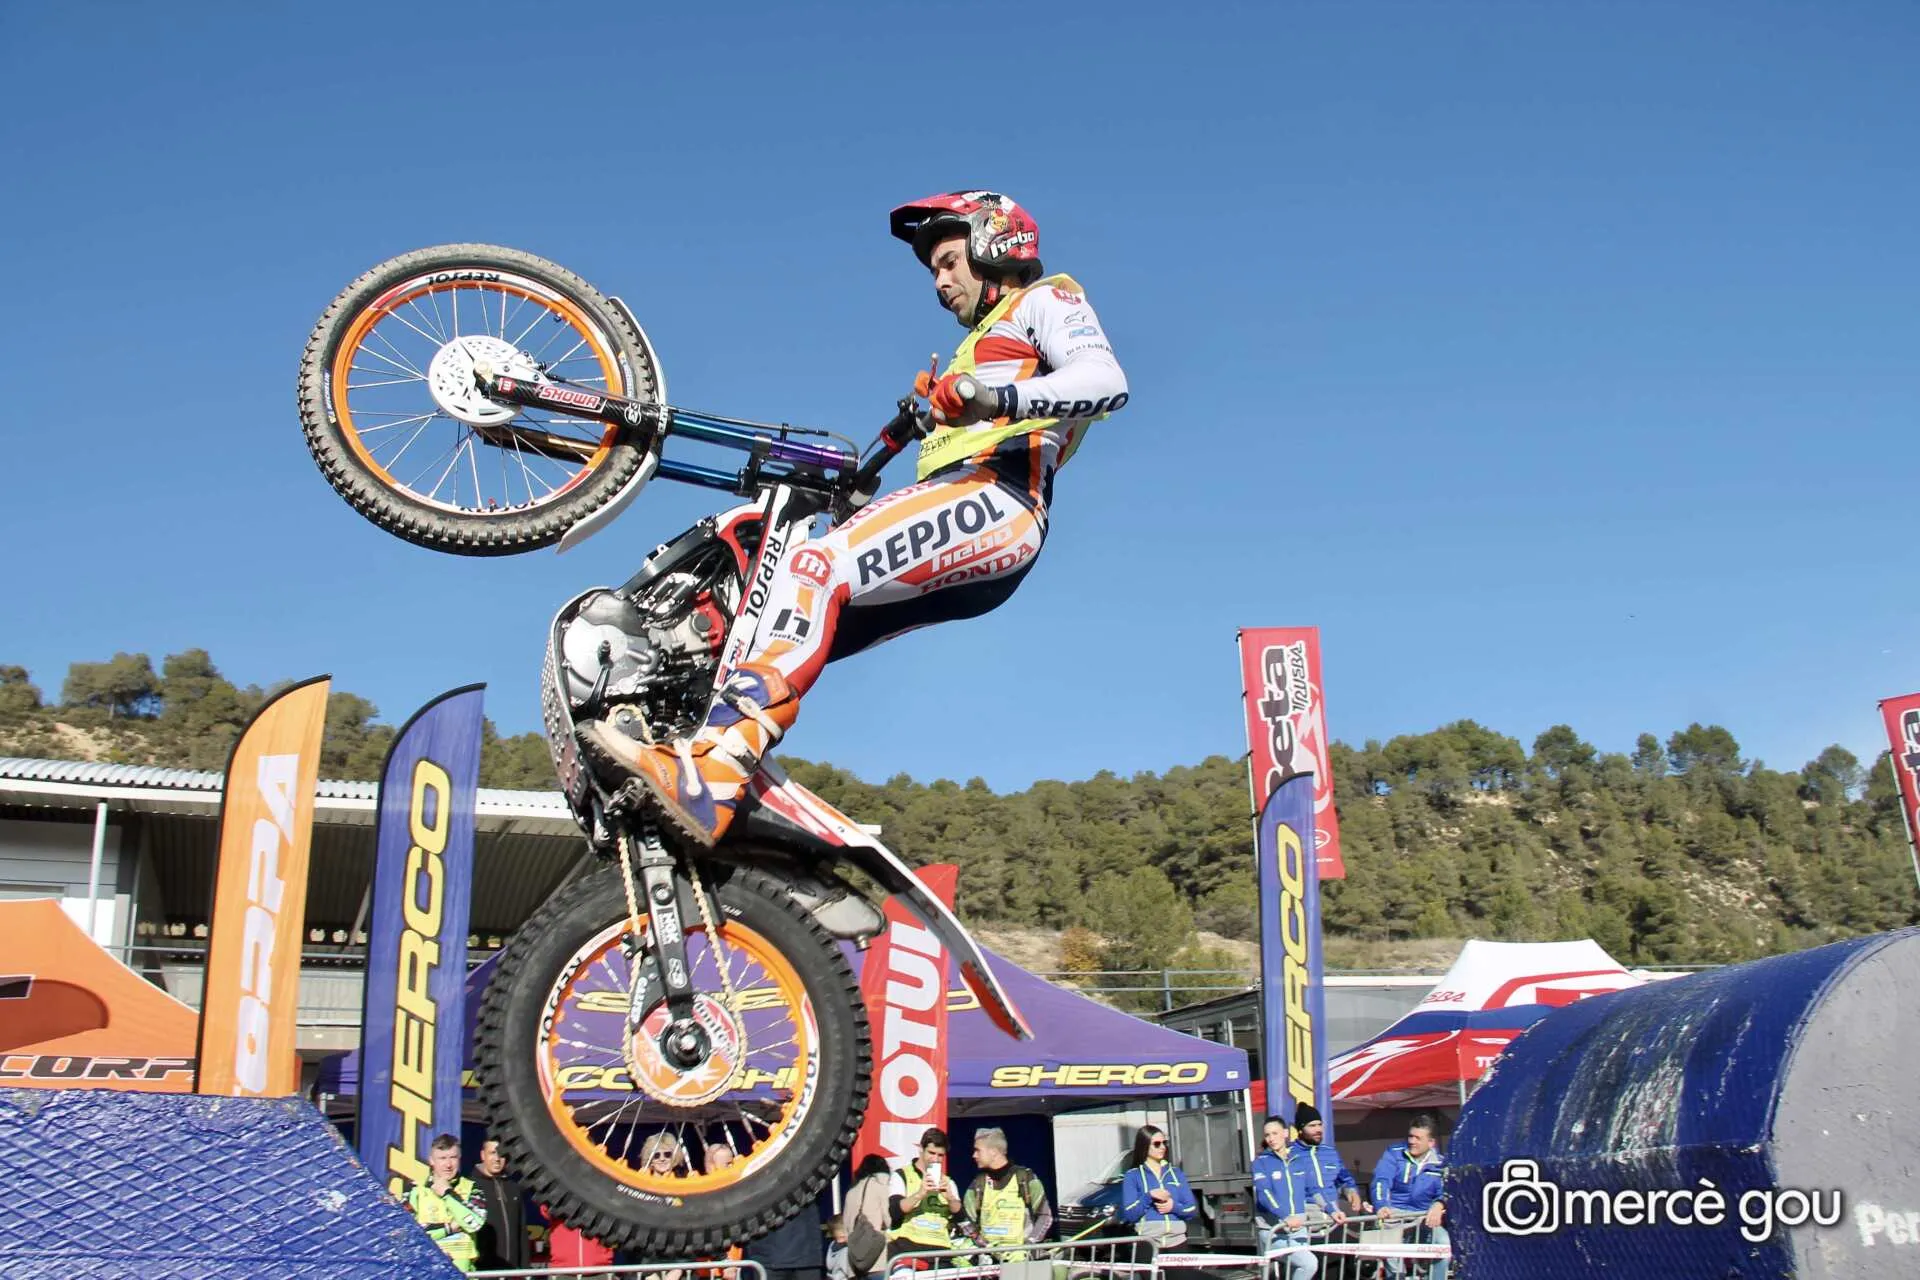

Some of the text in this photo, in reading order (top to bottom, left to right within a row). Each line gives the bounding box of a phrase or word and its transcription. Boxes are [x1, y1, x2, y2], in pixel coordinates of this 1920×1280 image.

[540, 386, 601, 410] SHOWA
[856, 491, 1005, 586] REPSOL
[744, 536, 782, 619] REPSOL
[920, 542, 1034, 593] HONDA
[541, 956, 581, 1043] REPSOL
[0, 1055, 195, 1081] CORP
[990, 1061, 1209, 1088] SHERCO
